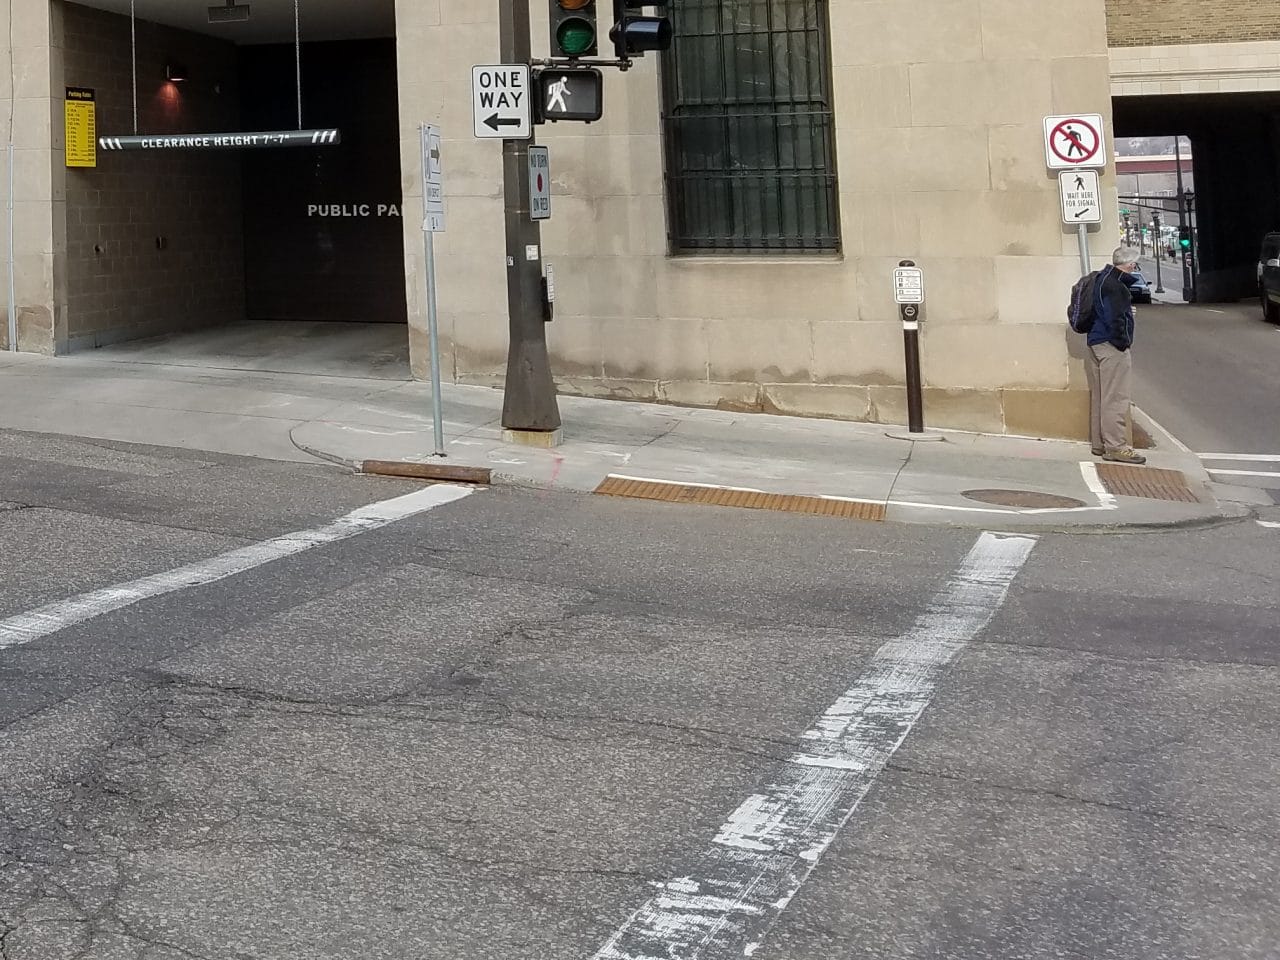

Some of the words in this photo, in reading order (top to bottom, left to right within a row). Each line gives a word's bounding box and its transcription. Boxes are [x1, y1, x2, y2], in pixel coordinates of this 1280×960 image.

[479, 71, 522, 88] ONE
[479, 92, 522, 108] WAY
[141, 137, 210, 149] CLEARANCE
[214, 135, 258, 147] HEIGHT
[263, 134, 290, 144] 7'-7"
[1081, 191, 1094, 199] HERE
[1078, 199, 1096, 207] SIGNAL
[307, 204, 370, 217] PUBLIC
[377, 204, 403, 217] PA
